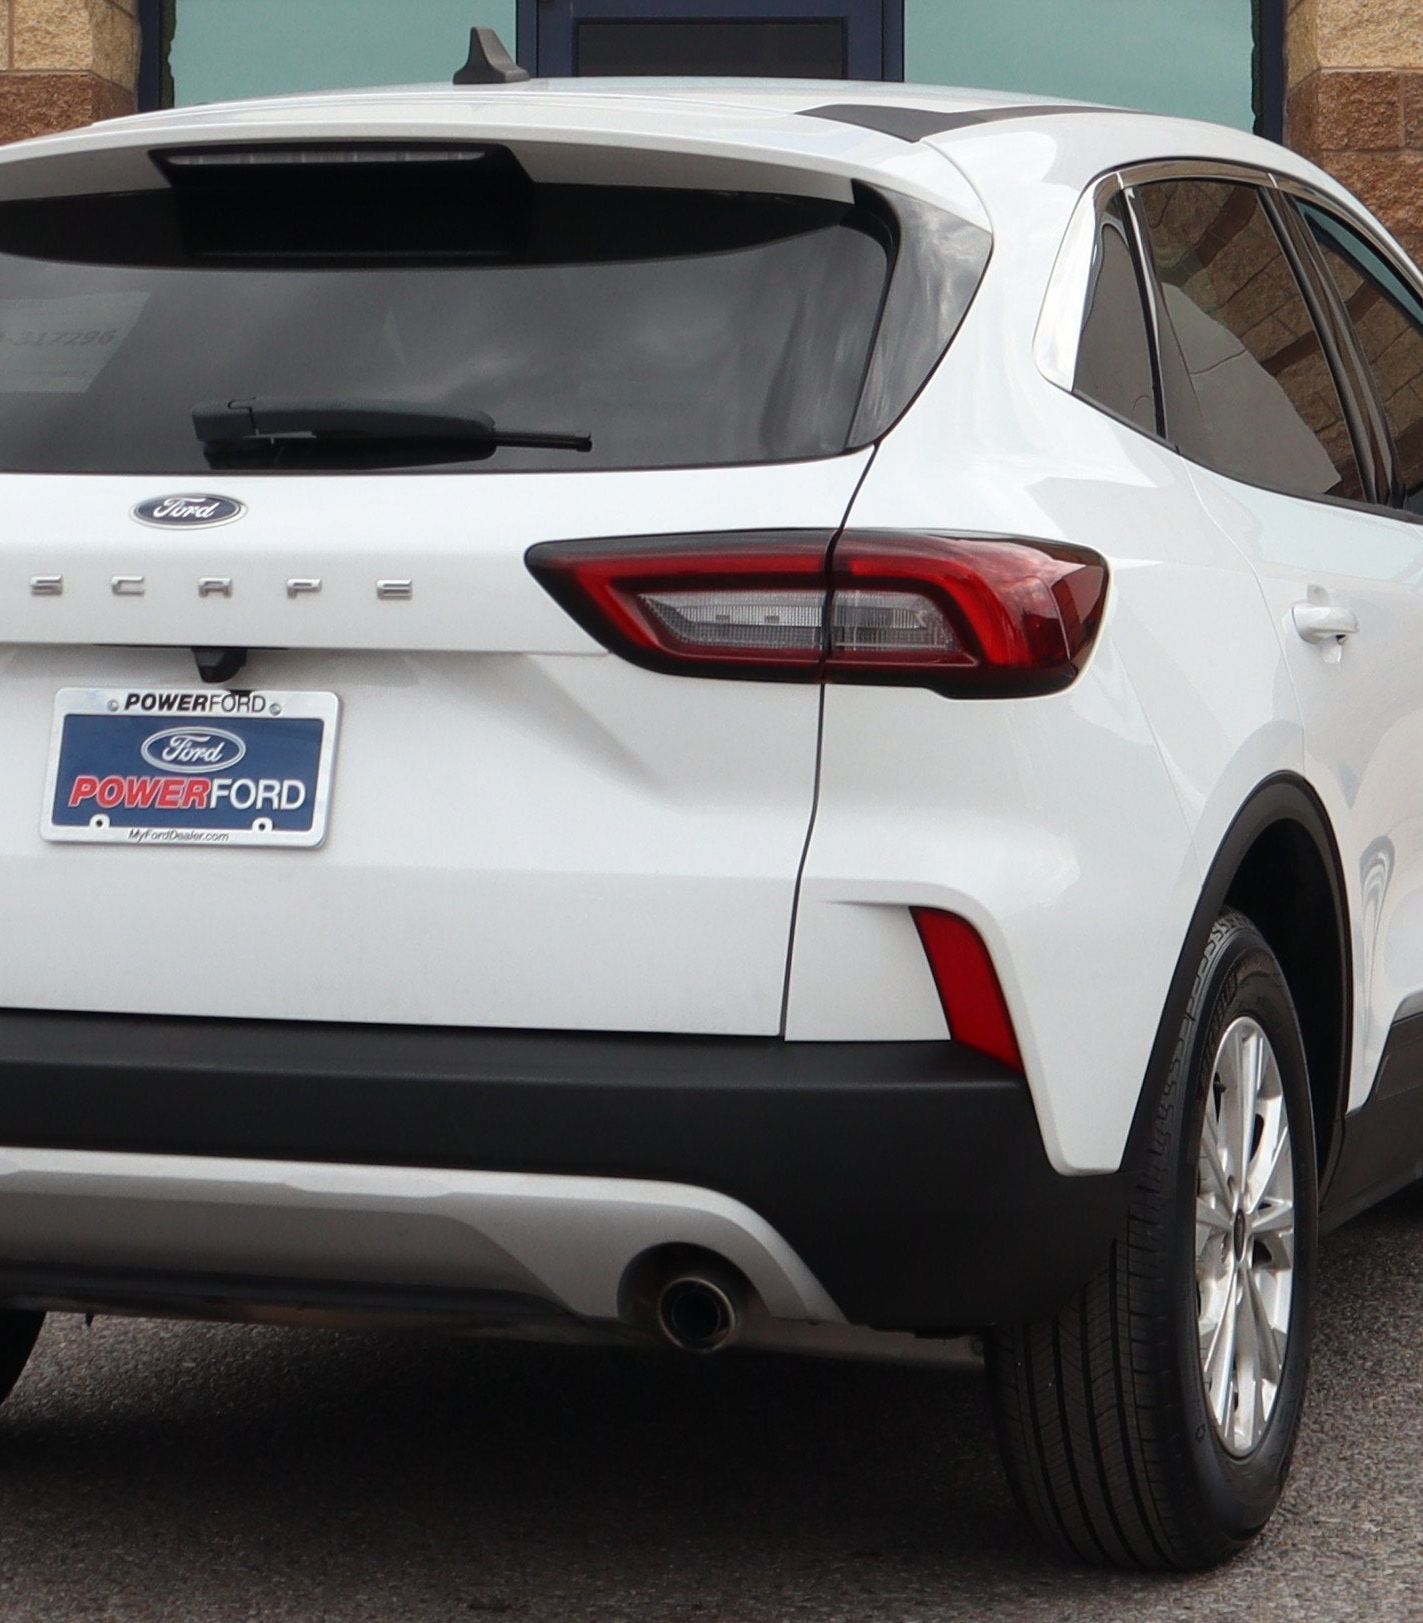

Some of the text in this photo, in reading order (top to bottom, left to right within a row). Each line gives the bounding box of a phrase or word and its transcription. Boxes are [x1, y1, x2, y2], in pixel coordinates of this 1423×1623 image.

[153, 497, 221, 518] Ford
[161, 734, 224, 764] Ford
[128, 828, 230, 843] MyFordDealer.com
